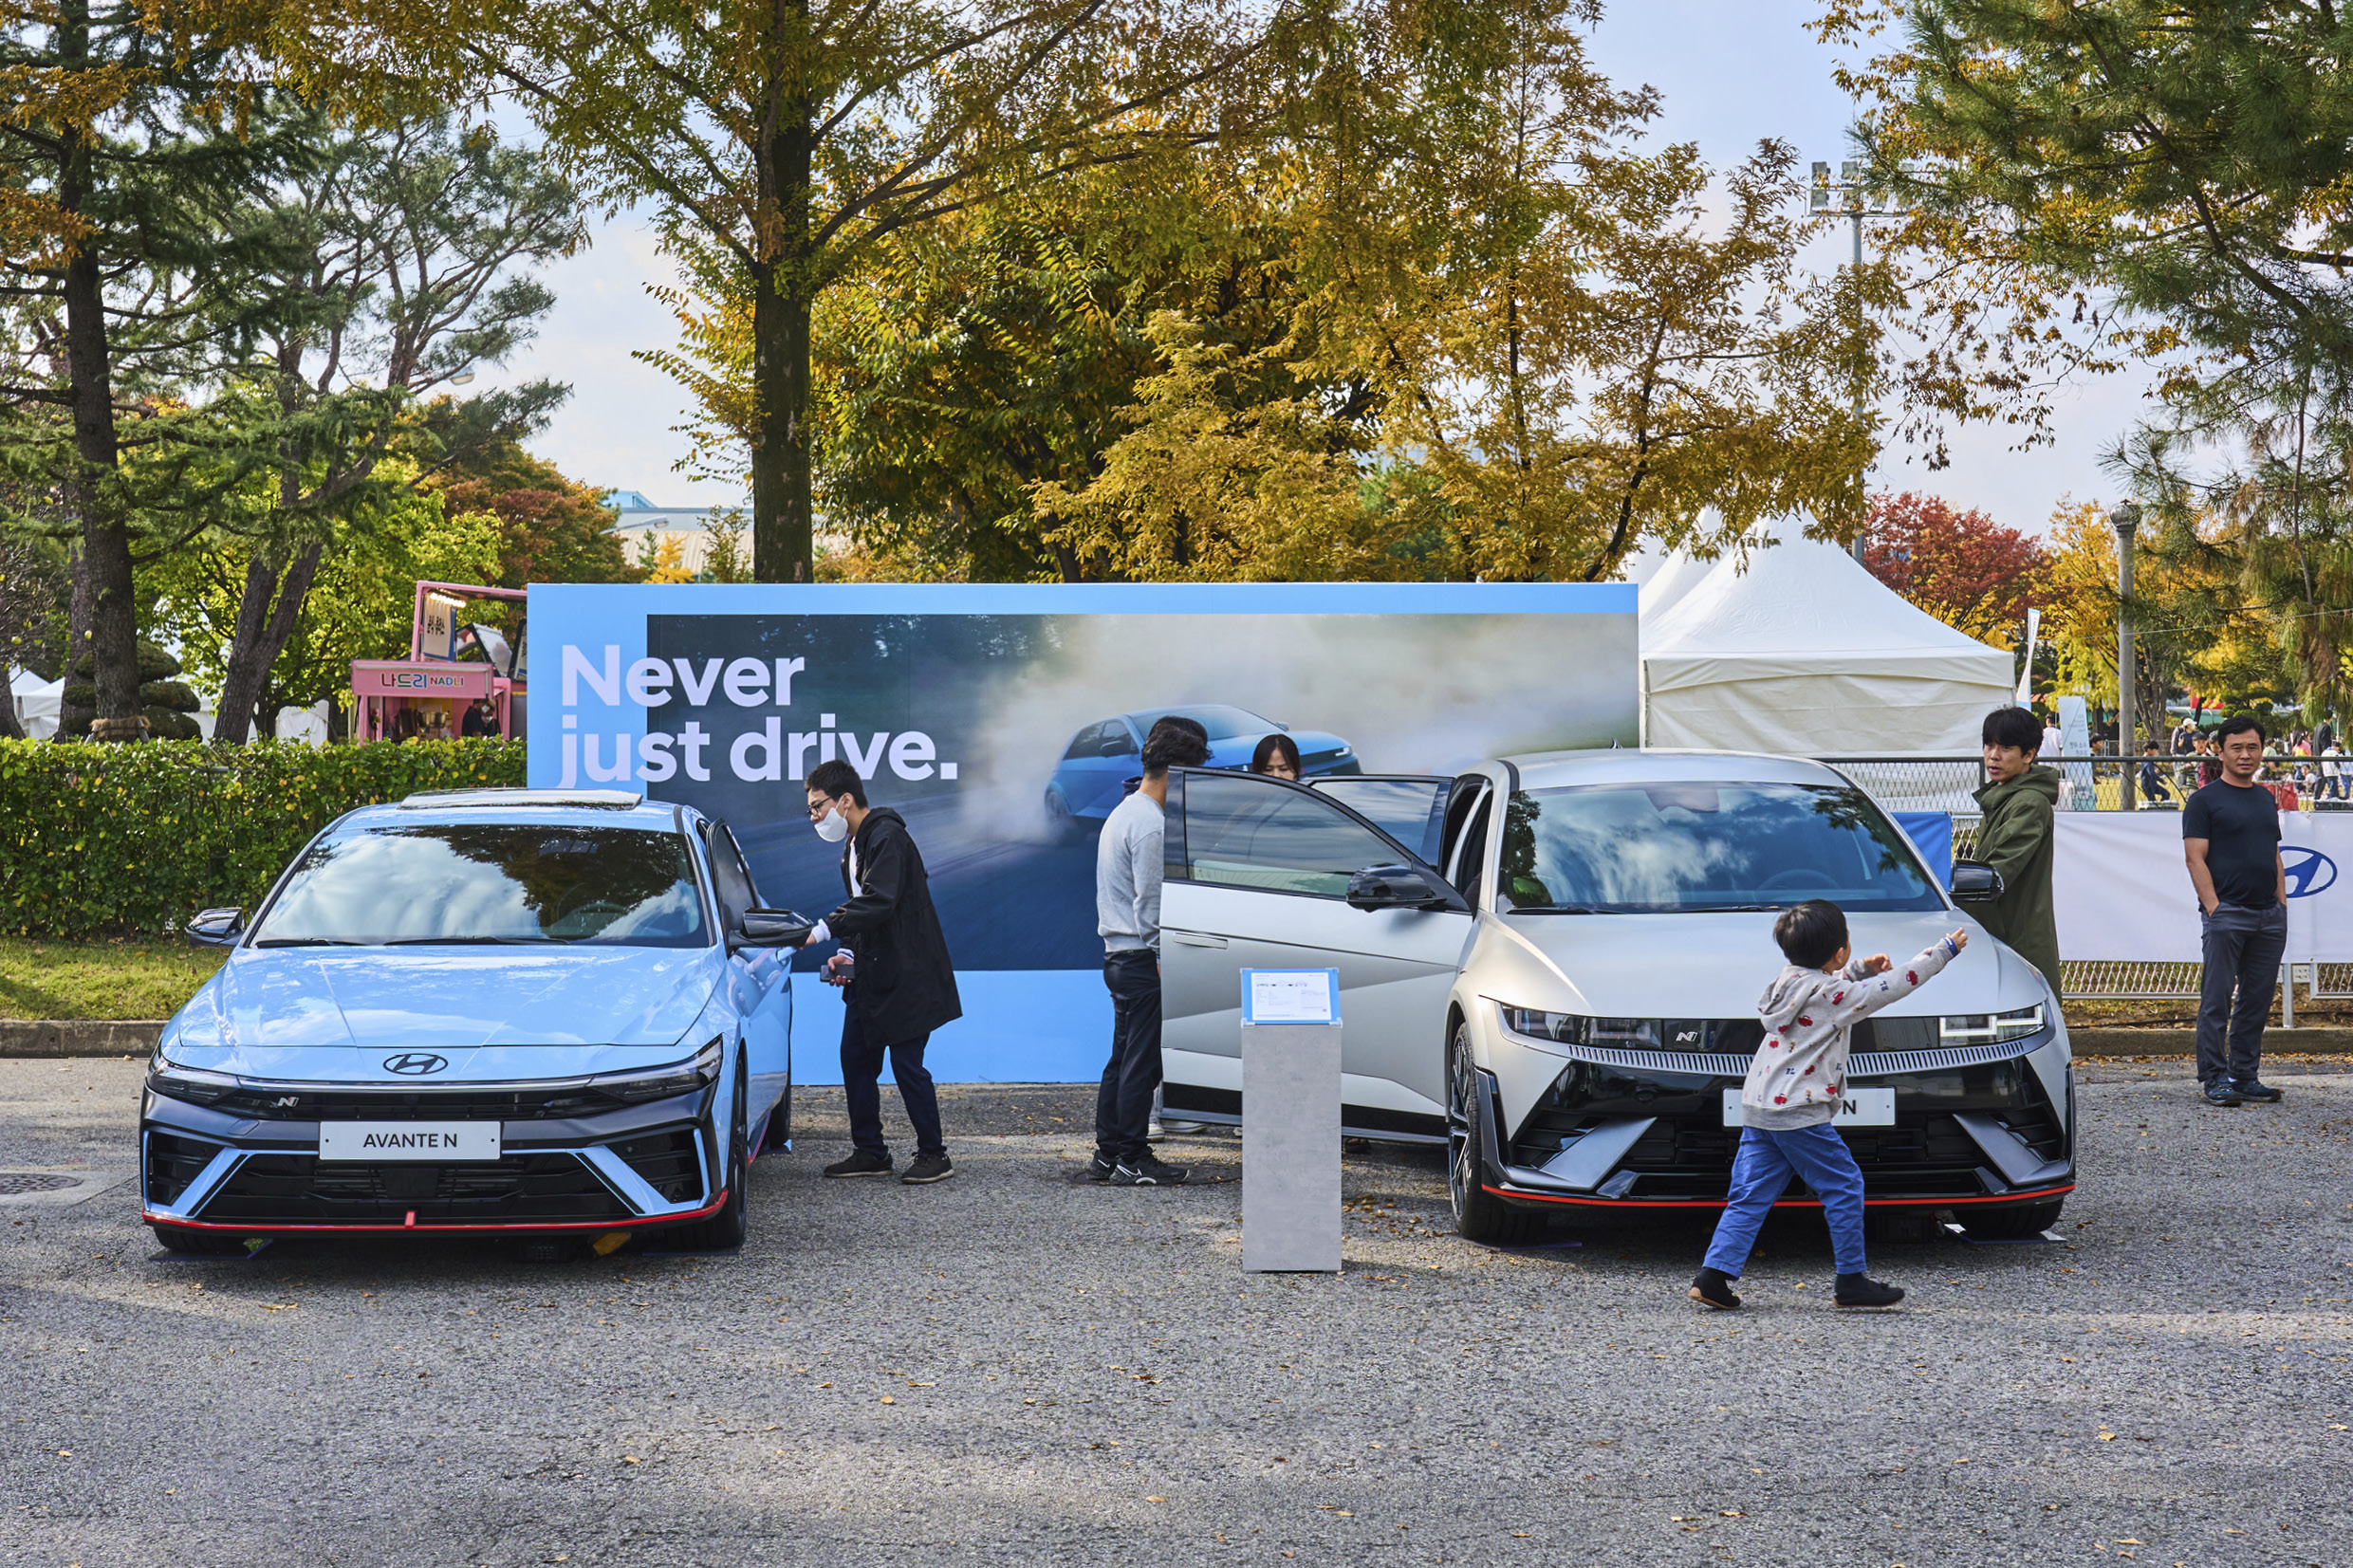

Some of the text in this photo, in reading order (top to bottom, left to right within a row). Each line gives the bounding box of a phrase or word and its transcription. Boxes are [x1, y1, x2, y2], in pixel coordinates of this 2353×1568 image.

[381, 673, 464, 689] 나드리 NADLI
[562, 644, 805, 707] Never
[554, 713, 958, 789] just drive.
[1843, 1099, 1857, 1115] N
[362, 1134, 457, 1148] AVANTE N
